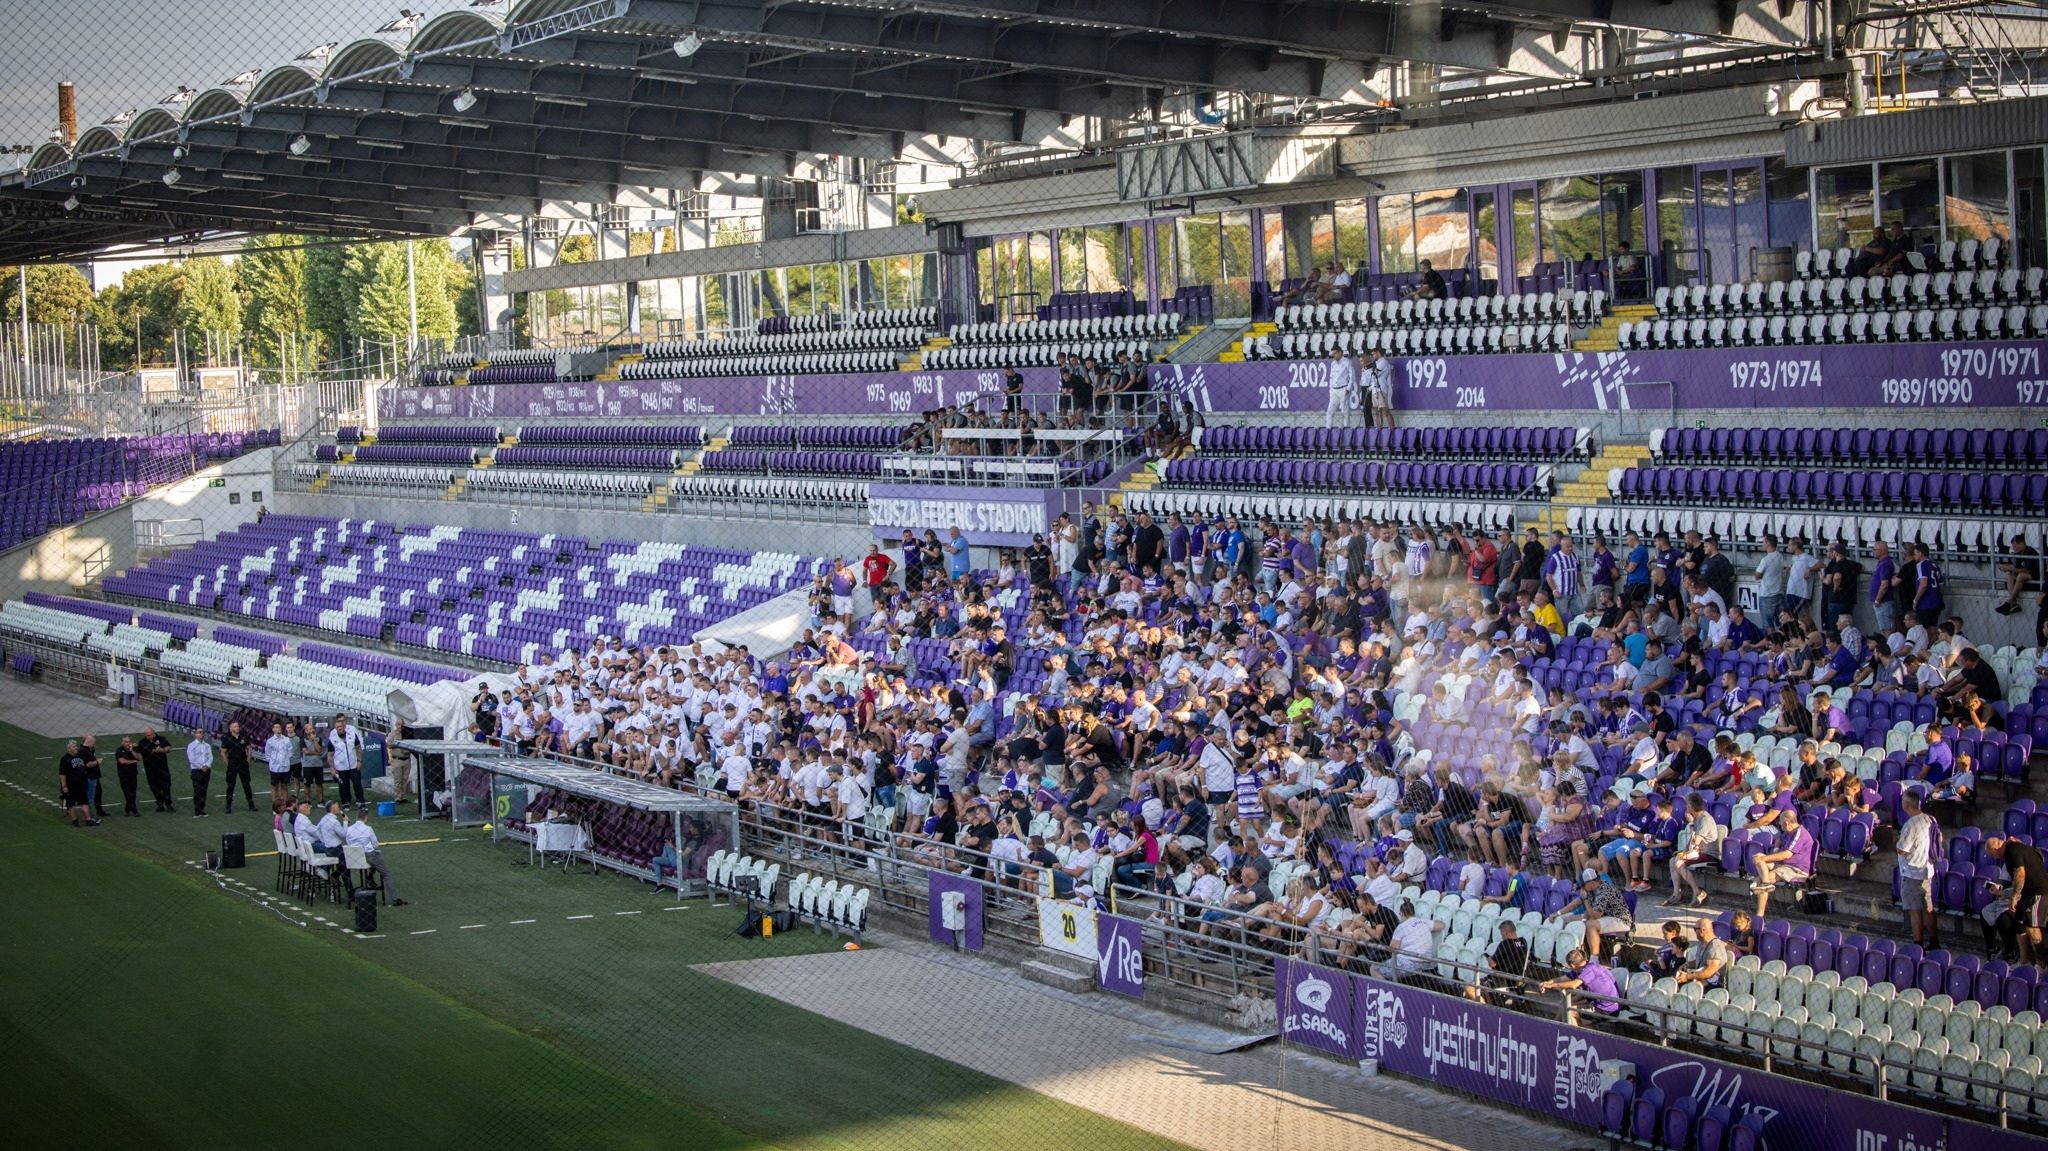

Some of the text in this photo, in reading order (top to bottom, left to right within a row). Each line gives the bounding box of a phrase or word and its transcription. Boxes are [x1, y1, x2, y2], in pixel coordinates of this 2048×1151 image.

[1288, 362, 1328, 388] 2002
[1405, 358, 1448, 389] 1992
[1730, 360, 1822, 391] 1973/1974
[1940, 347, 2040, 380] 1970/1971
[867, 384, 885, 402] 1975
[913, 375, 933, 395] 1983
[978, 372, 1000, 392] 1982
[1881, 378, 1972, 406] 1989/1990
[608, 400, 621, 415] 1969
[889, 391, 911, 412] 1969
[1259, 385, 1290, 409] 2018
[1456, 386, 1486, 408] 2014
[868, 497, 1042, 533] SZUSZA FERENC STADION
[1738, 587, 1758, 610] A1
[1062, 912, 1076, 939] 20
[1118, 937, 1143, 984] Re
[1285, 1012, 1347, 1049] EL SABOR
[1363, 983, 1379, 1057] ÚJPEST
[1383, 1018, 1408, 1044] SHOP
[1552, 1029, 1570, 1110] ÚJPEST
